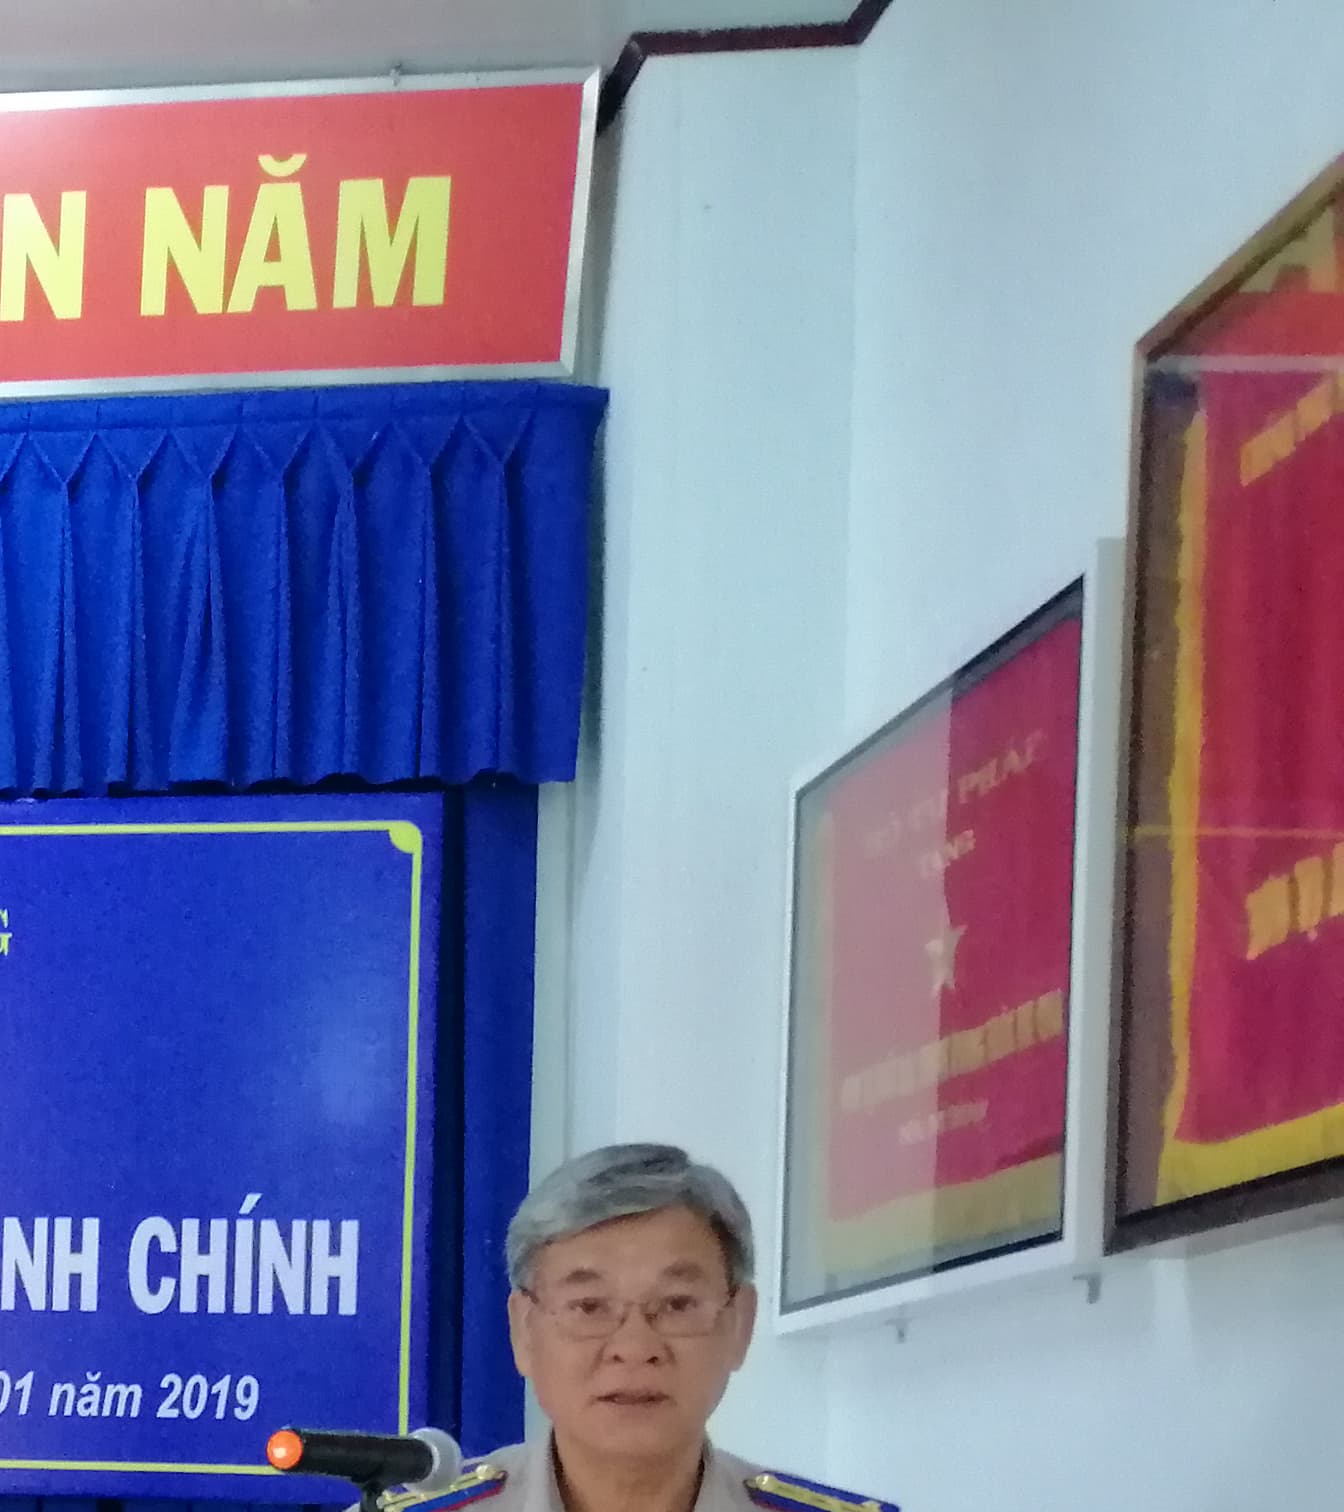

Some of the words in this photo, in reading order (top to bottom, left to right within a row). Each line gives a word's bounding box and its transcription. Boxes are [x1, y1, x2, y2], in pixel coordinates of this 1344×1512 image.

[140, 153, 452, 317] NĂM
[127, 1194, 360, 1316] CHÍNH
[47, 1371, 143, 1418] năm
[156, 1372, 259, 1421] 2019
